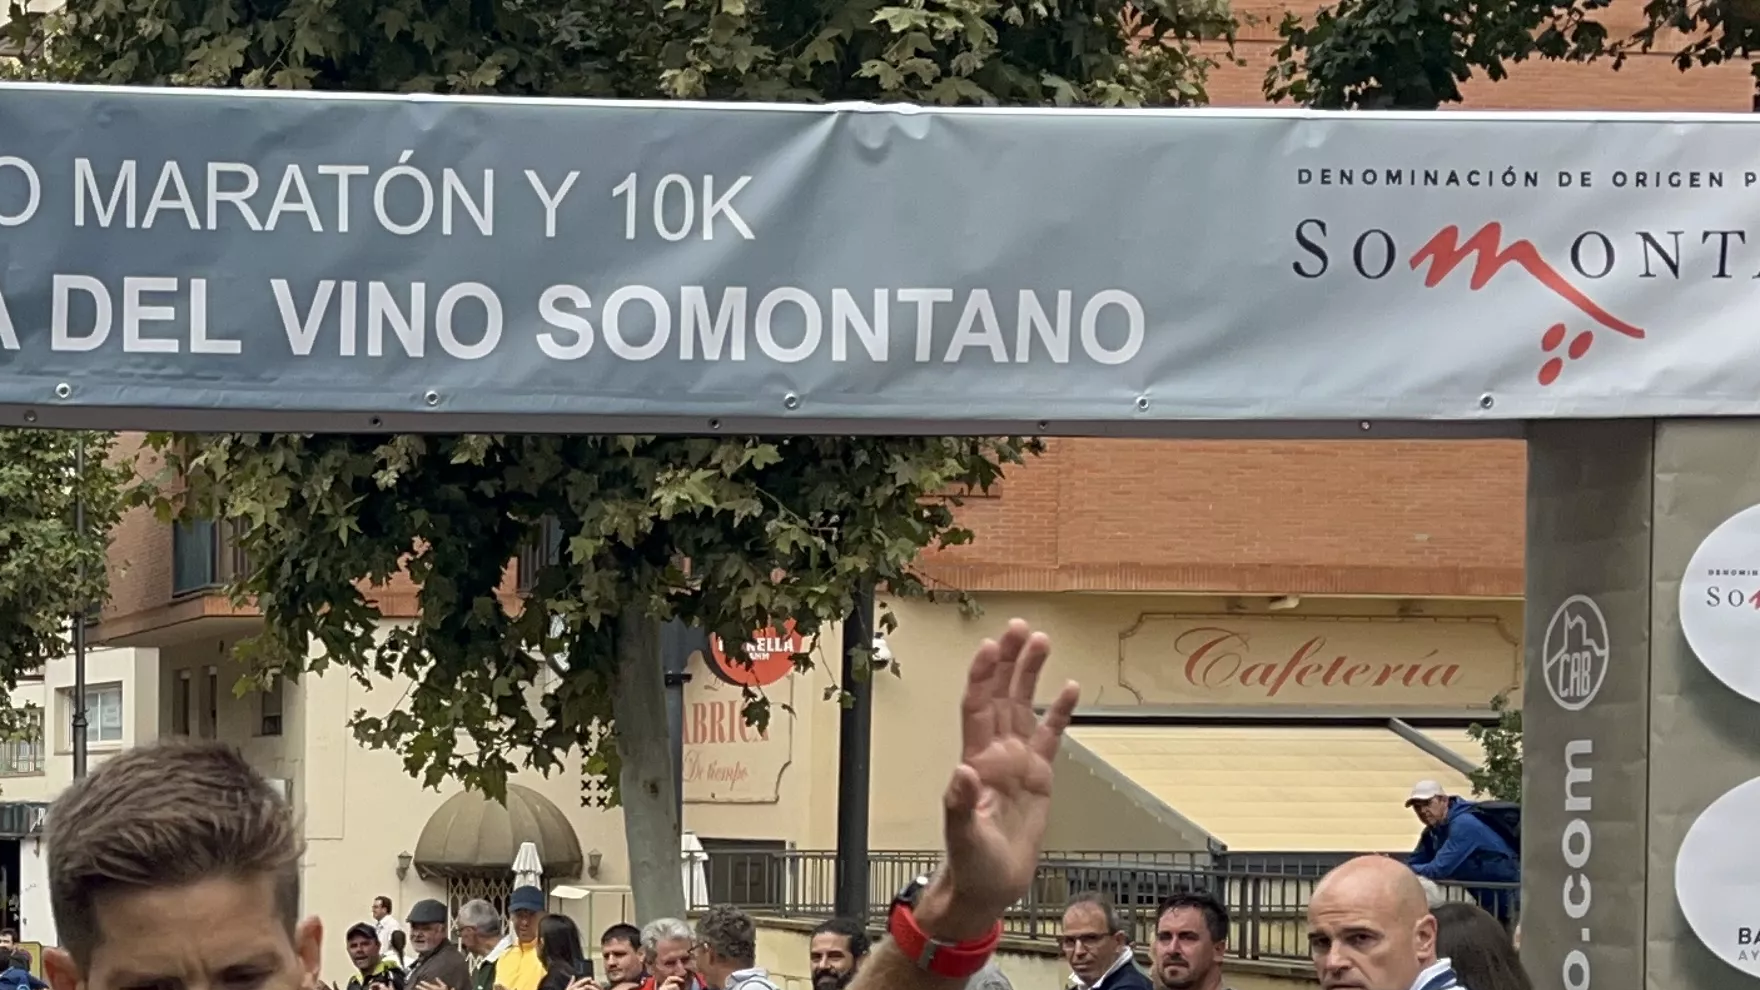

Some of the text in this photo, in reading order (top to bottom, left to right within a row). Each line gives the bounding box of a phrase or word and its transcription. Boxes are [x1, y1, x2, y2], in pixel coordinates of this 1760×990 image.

[73, 149, 495, 236] MARATÓN
[524, 169, 580, 240] Y
[610, 172, 756, 242] 10K
[1297, 165, 1539, 188] DENOMINACIÓN
[1558, 170, 1594, 188] DE
[1612, 170, 1724, 189] ORIGEN
[1292, 217, 1760, 315] SOMONT
[51, 273, 242, 354] DEL
[270, 278, 504, 360] VINO
[536, 282, 1146, 366] SOMONTANO
[1708, 568, 1760, 577] DENOMIN
[1174, 626, 1463, 698] Cafetería
[1557, 650, 1592, 697] CAB
